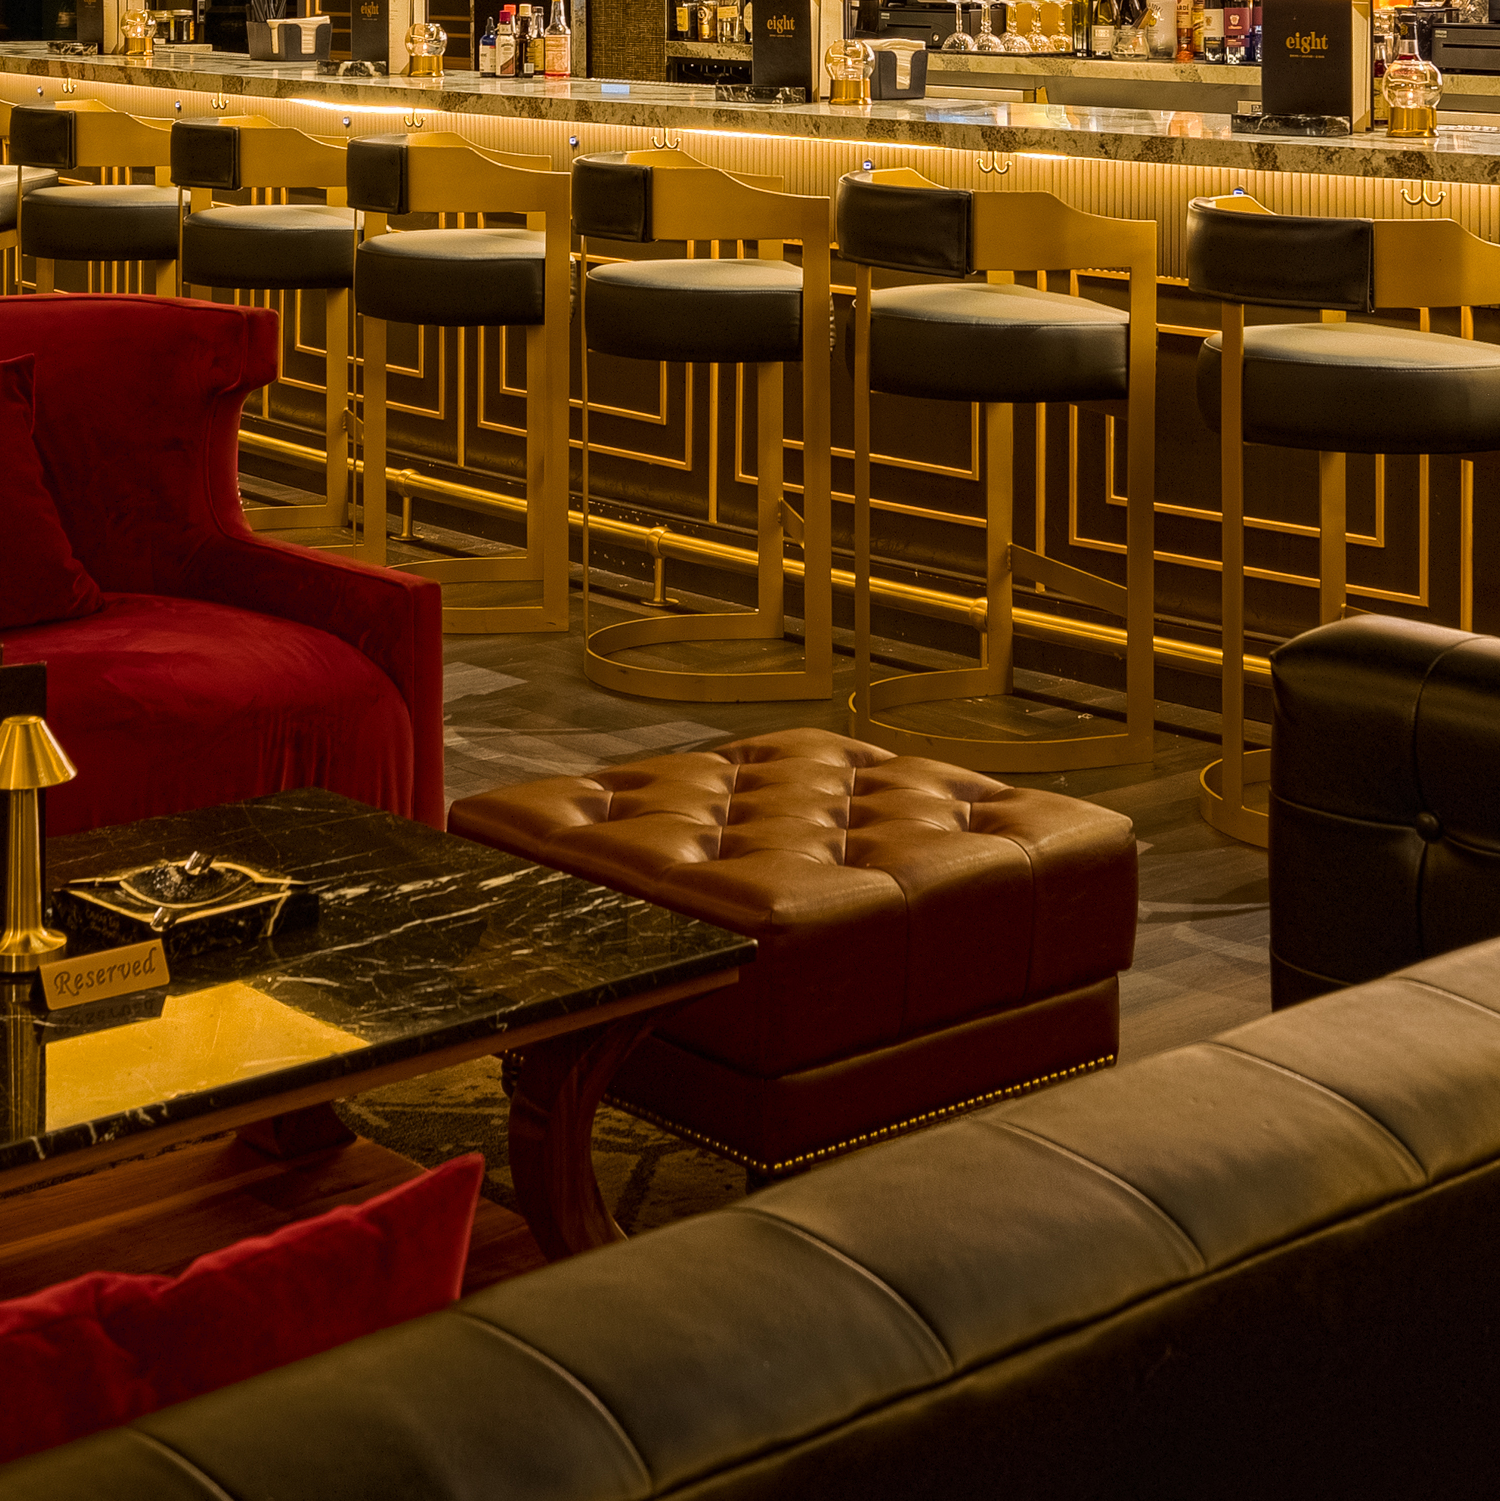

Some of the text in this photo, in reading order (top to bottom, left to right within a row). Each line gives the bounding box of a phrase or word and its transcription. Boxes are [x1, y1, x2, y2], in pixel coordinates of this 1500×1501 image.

[360, 1, 380, 16] eight
[767, 15, 796, 33] eight
[1285, 31, 1329, 54] eight
[53, 947, 157, 998] Reserved
